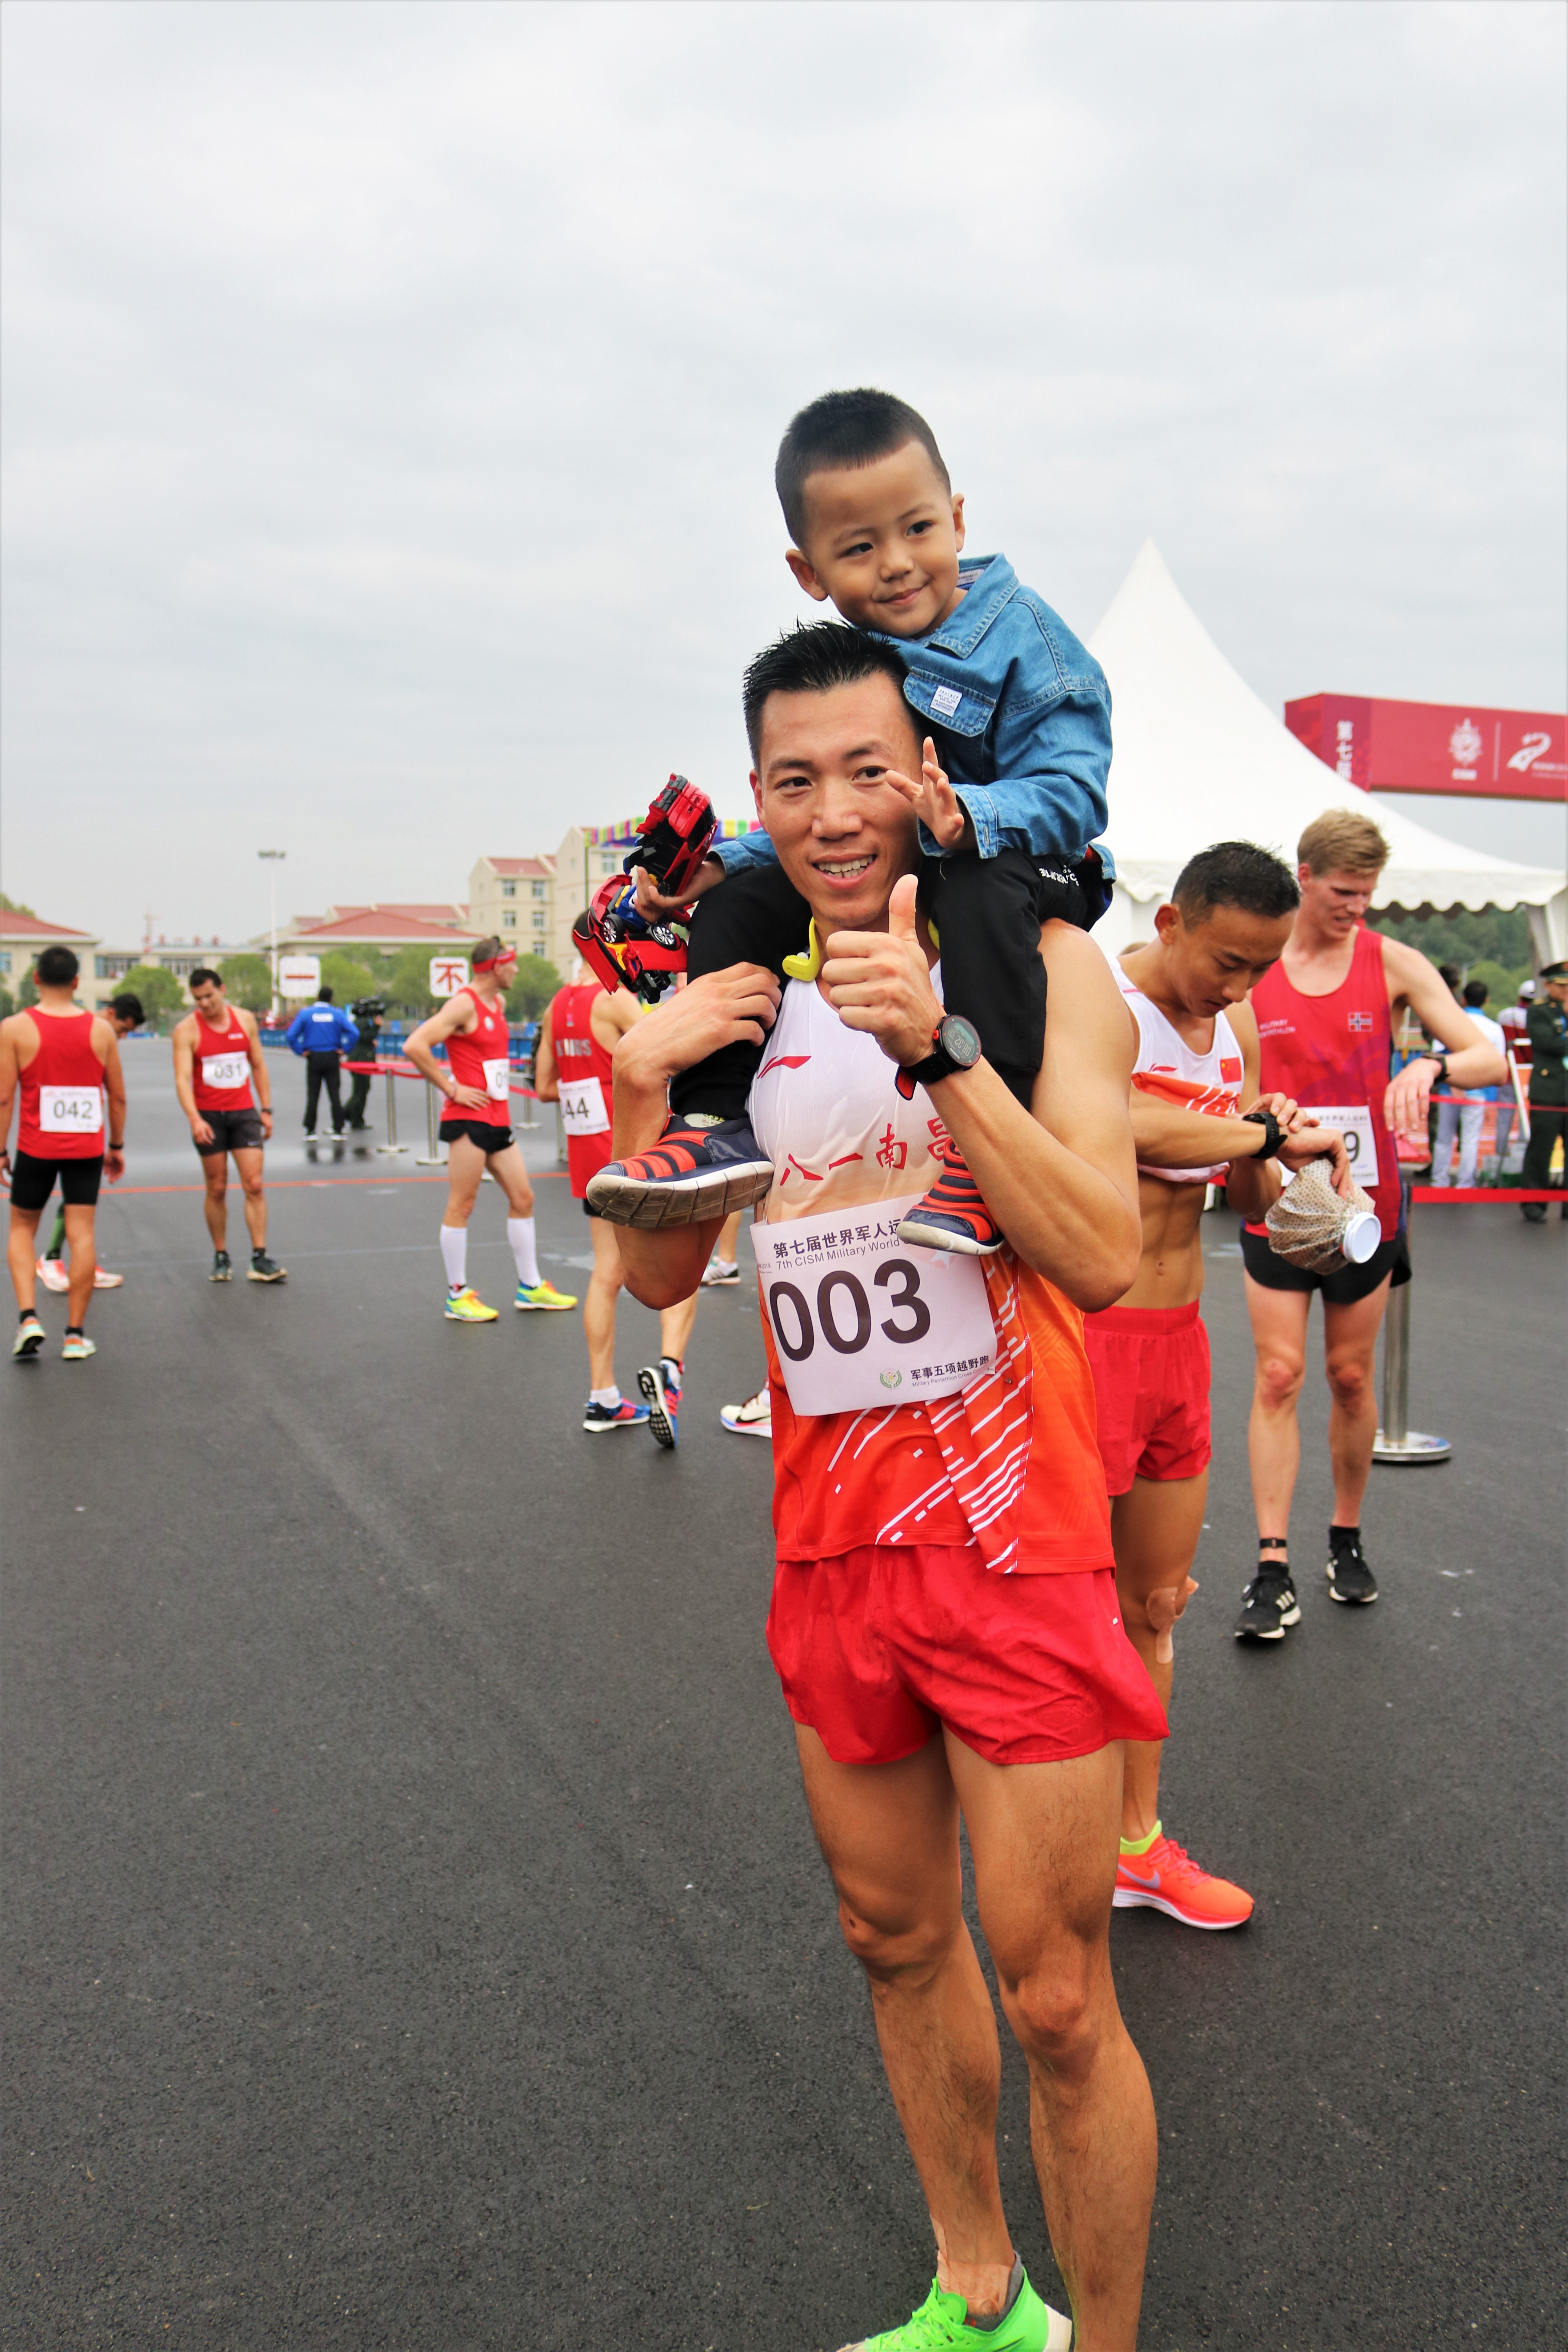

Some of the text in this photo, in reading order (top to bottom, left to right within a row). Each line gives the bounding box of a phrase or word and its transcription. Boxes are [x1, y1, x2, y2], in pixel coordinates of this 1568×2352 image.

[435, 964, 465, 992] 不
[53, 1100, 92, 1118] 042
[776, 1238, 900, 1270] 7th CISM Military World
[769, 1258, 931, 1362] 003
[911, 1355, 989, 1380] 军事五项越野跑
